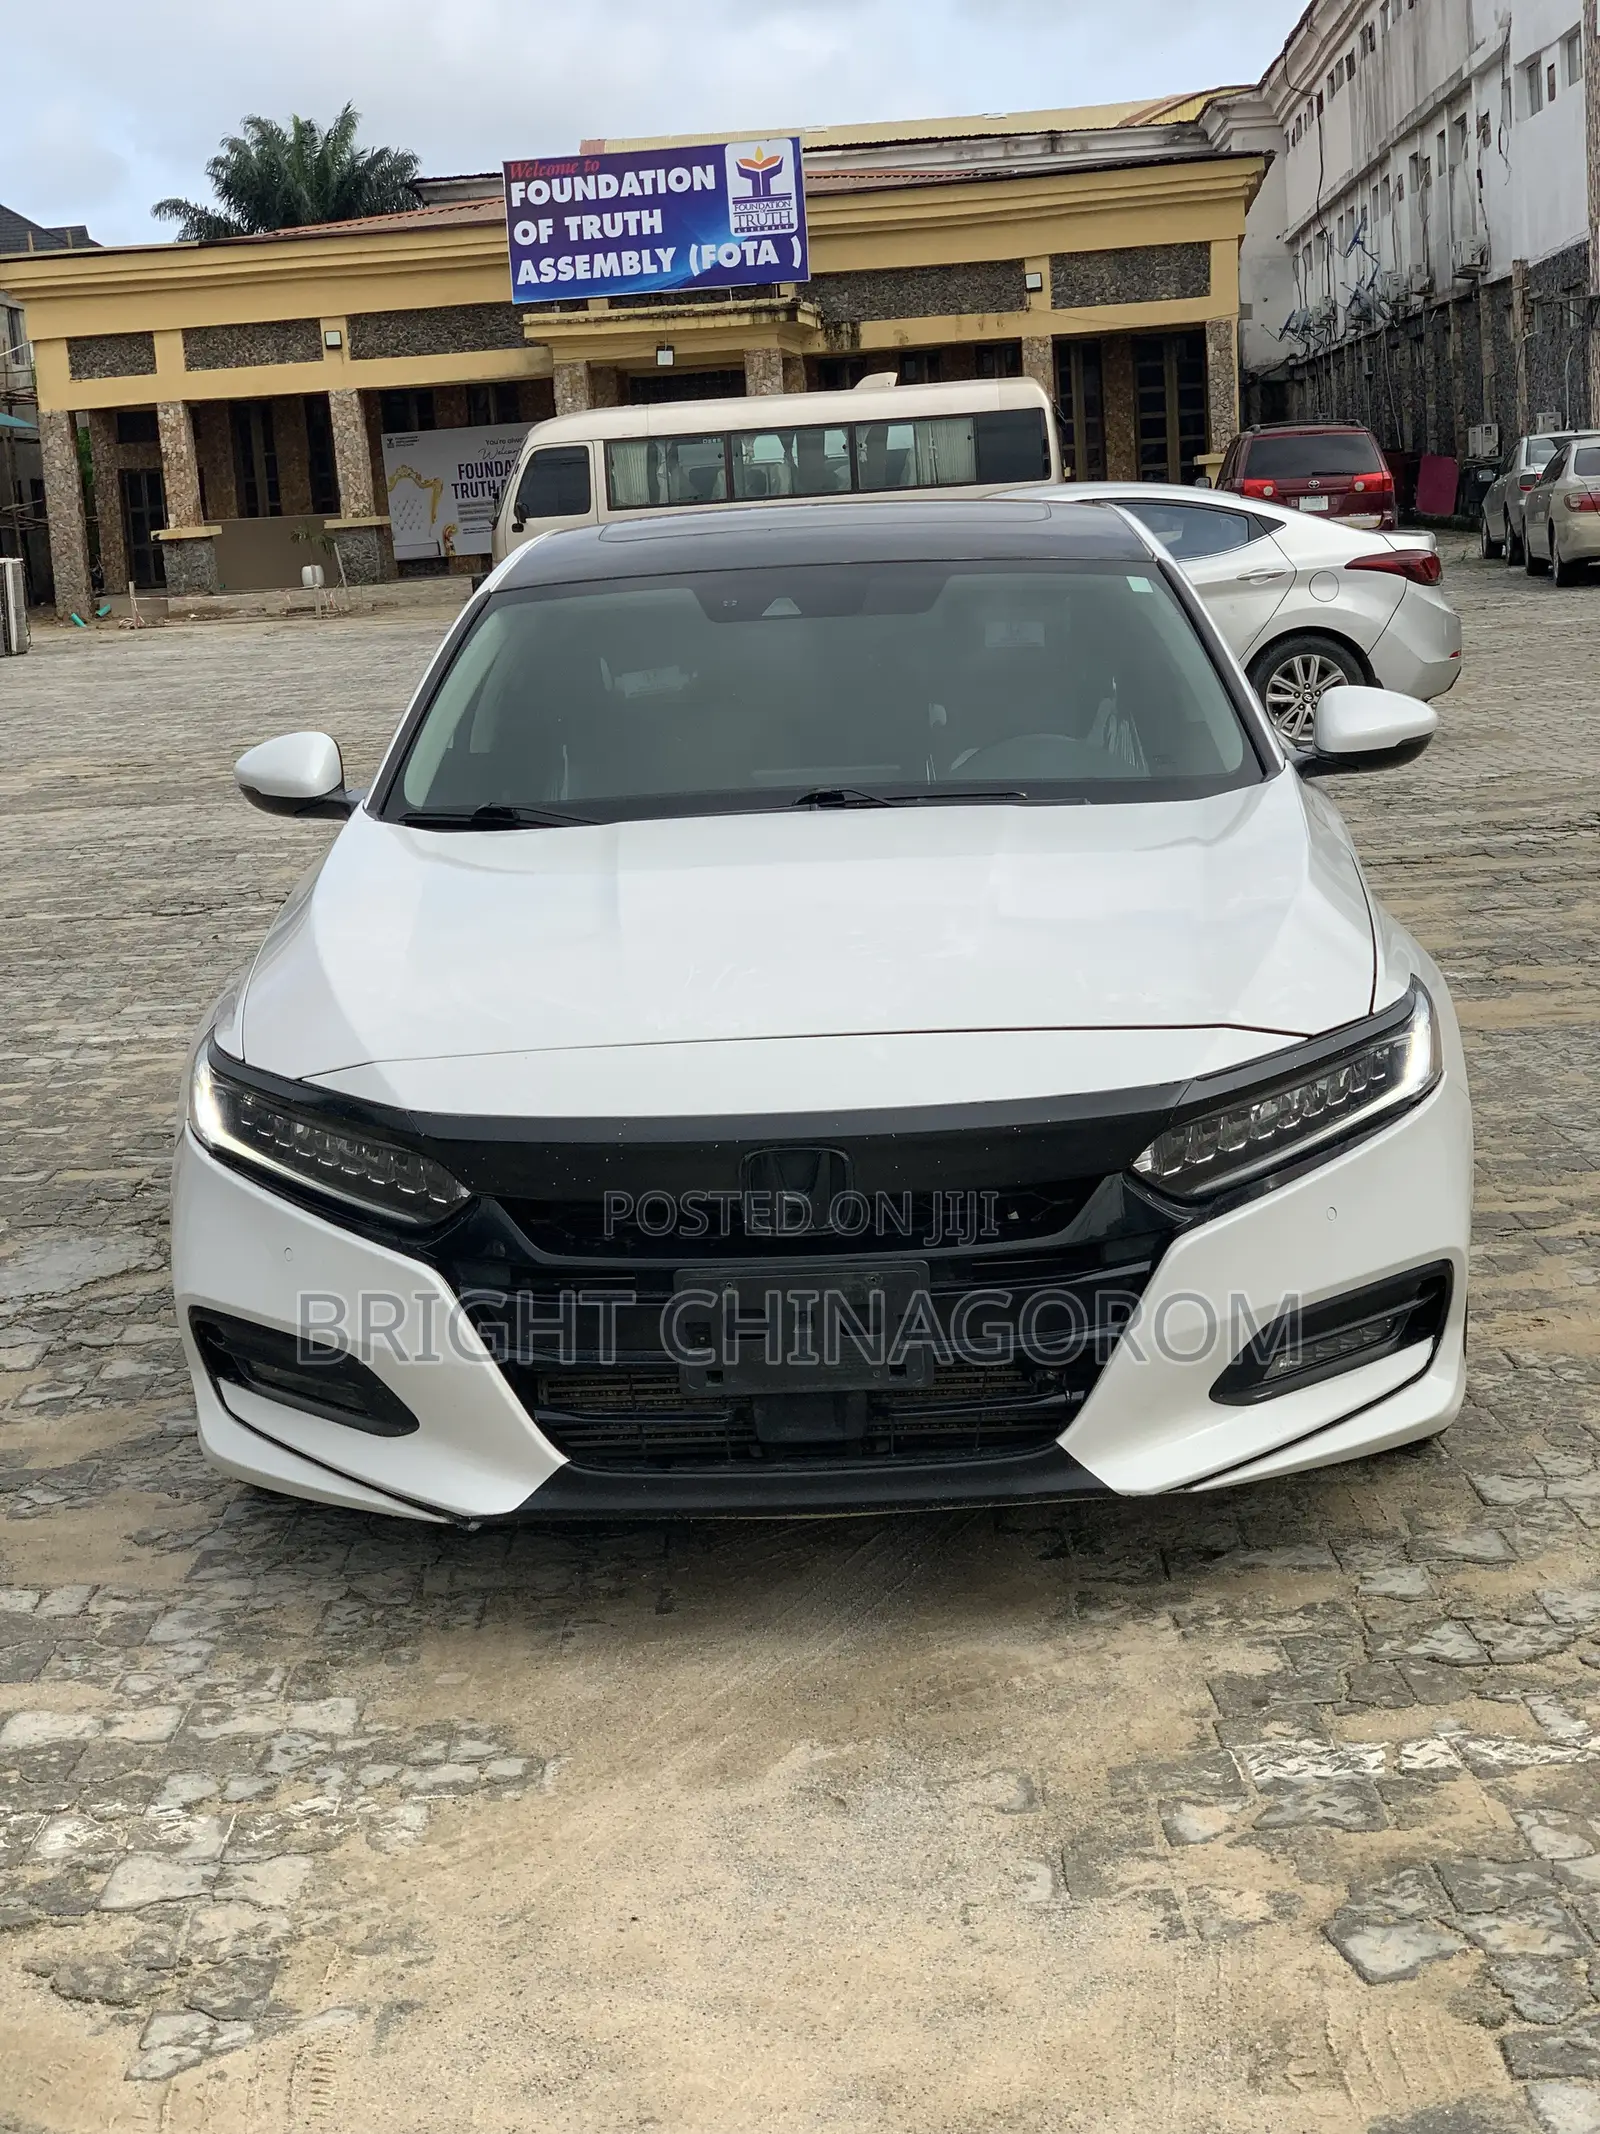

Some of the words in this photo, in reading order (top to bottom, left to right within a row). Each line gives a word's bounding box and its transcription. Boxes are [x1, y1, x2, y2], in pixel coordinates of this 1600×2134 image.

[508, 161, 579, 179] Welcome
[584, 159, 600, 173] to
[510, 165, 715, 207] FOUNDATION
[734, 200, 791, 211] FOUNDATION
[514, 219, 554, 246] OF
[564, 209, 663, 241] TRUTH
[734, 211, 791, 227] TRUTH
[516, 246, 676, 285] ASSEMBLY
[485, 438, 506, 446] You're
[457, 459, 514, 480] FOUNDA
[451, 479, 496, 499] TRUTH
